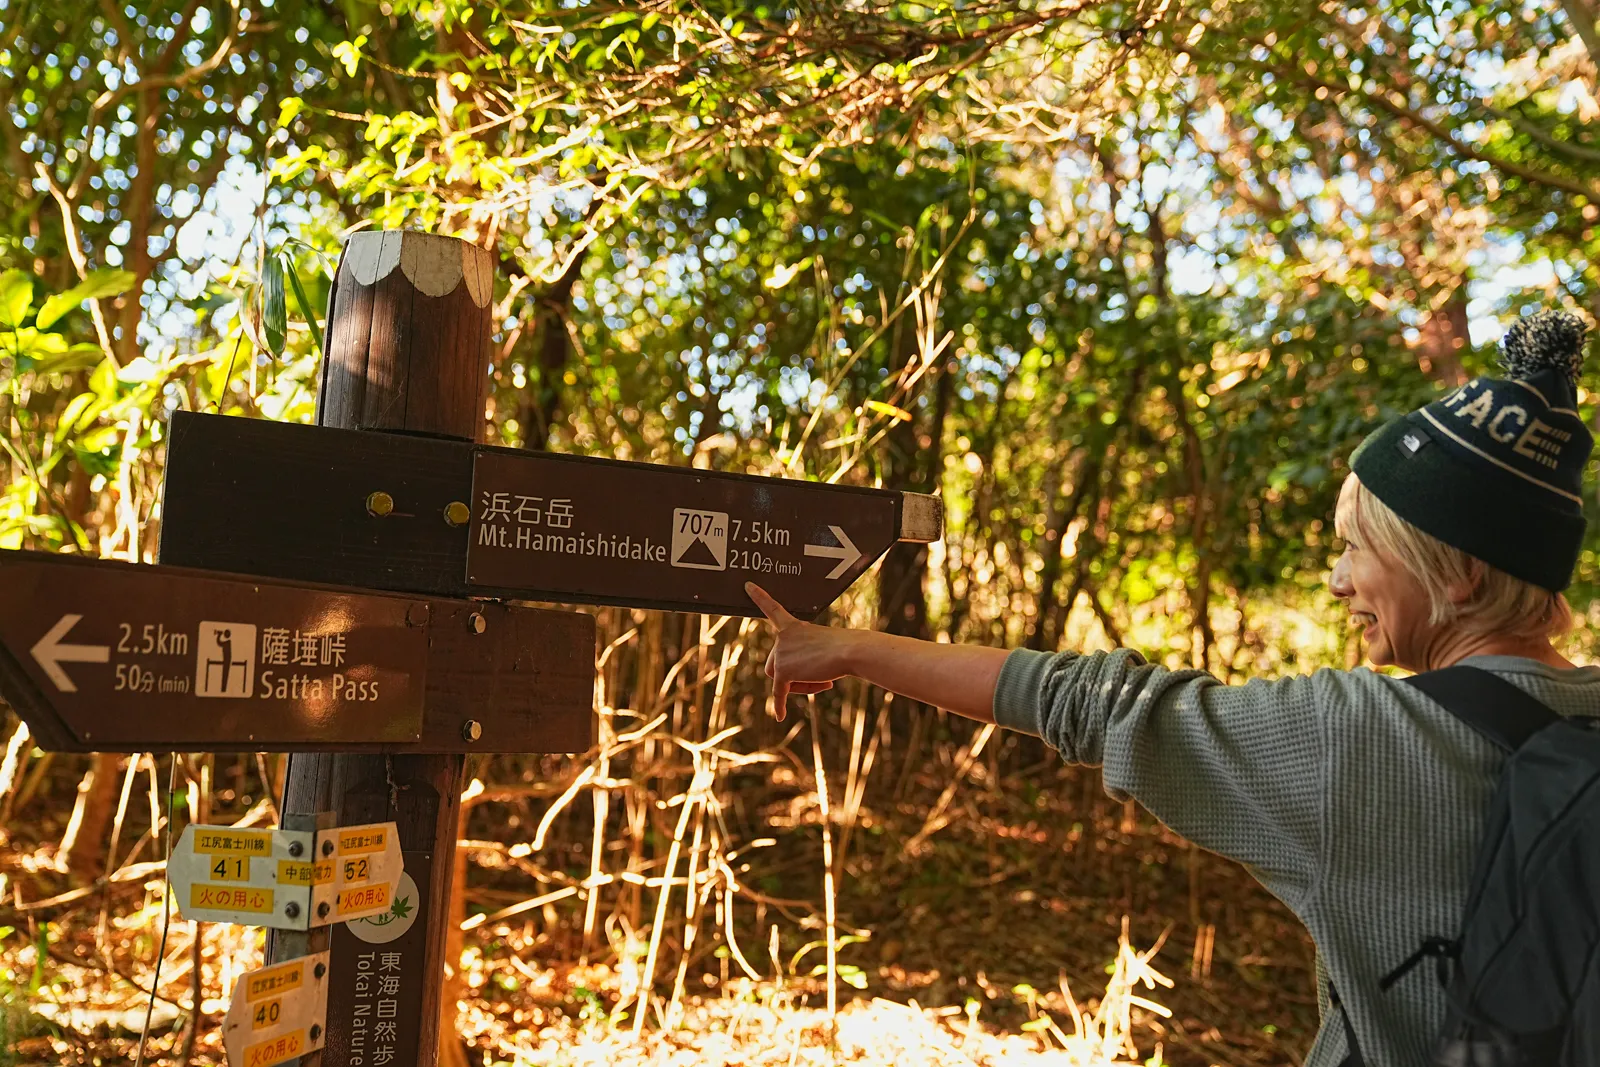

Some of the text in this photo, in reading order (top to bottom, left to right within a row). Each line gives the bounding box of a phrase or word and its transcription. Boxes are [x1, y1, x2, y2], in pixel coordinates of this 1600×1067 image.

[481, 490, 574, 529] 浜石岳
[731, 520, 791, 547] 7.5km
[117, 622, 189, 656] 2.5km
[261, 626, 347, 668] 薩埵峠
[260, 670, 380, 702] Satta Pass
[201, 836, 265, 851] 江尻富士川線
[213, 859, 243, 878] 41
[345, 860, 367, 880] 52
[199, 888, 265, 908] 火の用心
[344, 888, 385, 910] 火の用心
[256, 1002, 280, 1024] 40
[349, 951, 375, 1066] Tokai Nature
[372, 951, 403, 1067] 東海自然歩
[251, 1036, 298, 1067] 火の用心
